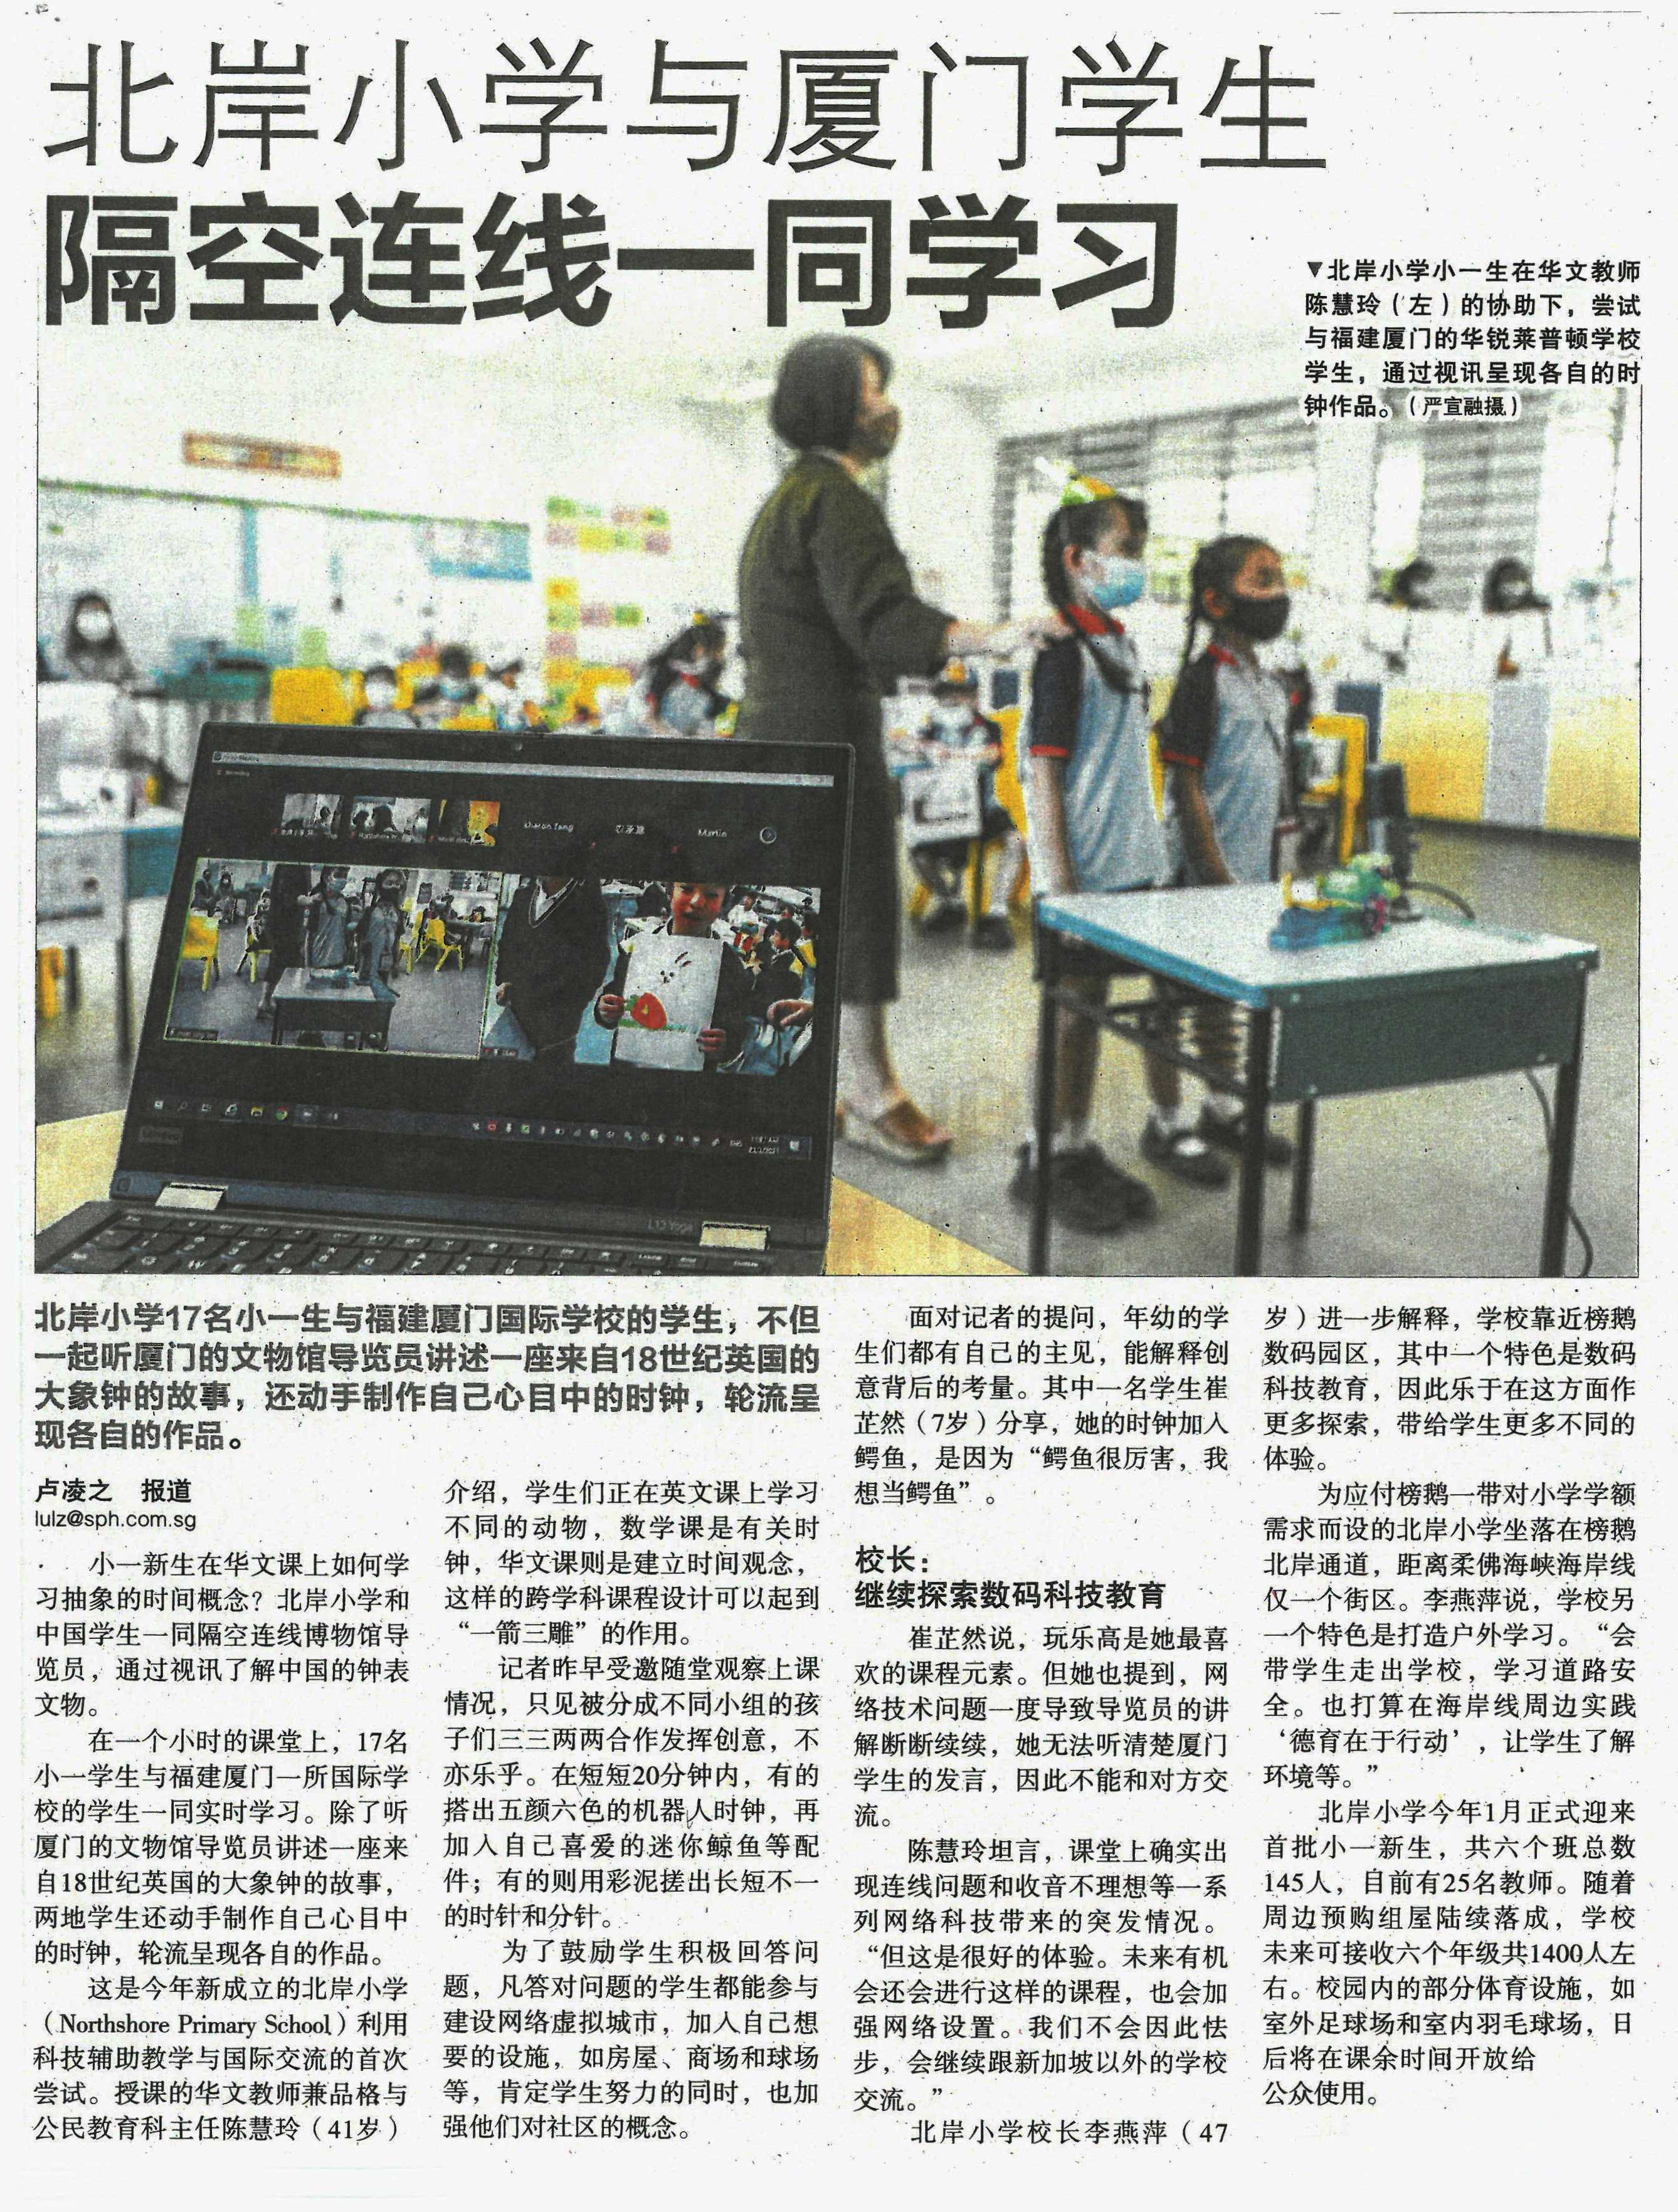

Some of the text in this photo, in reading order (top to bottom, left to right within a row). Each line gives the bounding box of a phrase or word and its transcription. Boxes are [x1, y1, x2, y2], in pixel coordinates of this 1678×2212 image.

[43, 35, 1327, 172] 北岸小学与厦门学生
[45, 190, 1179, 329] 隔空连线一同学习
[1327, 259, 1640, 282] 北岸小学小一生在华文教师
[1305, 292, 1641, 317] 陈慧玲（左）的协助下，尝试
[1305, 326, 1641, 350] 与福建厦门的华锐莱普顿学校
[1305, 361, 1640, 384] 学生，通过视讯呈现各自的时
[34, 1302, 820, 1335] 北岸小学17名小一生与福建厦门国际学校的学生，不但
[909, 1305, 1229, 1330] 面对记者的提问，年幼的学
[34, 1341, 820, 1374] 一起听厦门的文物馆导览员讲述一座来自18世纪英国的
[855, 1339, 1228, 1366] 生们都有自己的主见，能解释创
[1264, 1340, 1636, 1366] 数码园区，其中一个特色是数码
[34, 1380, 820, 1413] 大象钟的故事，还动手制作自己心目中的时钟，轮流呈
[855, 1374, 1228, 1400] 意背后的考量。其中一名学生崔
[1264, 1376, 1636, 1401] 科技教育，因此乐于在这方面作
[34, 1419, 243, 1450] 现各自的作品。
[1264, 1411, 1635, 1436] 更多探索，带给学生更多不同的
[1264, 1446, 1329, 1471] 体验。
[35, 1478, 191, 1502] 卢凌之 报道
[444, 1480, 818, 1505] 介绍，学生们正在英文课上学习
[1318, 1481, 1635, 1507] 为应付榜鹅一带对小学学额
[35, 1510, 196, 1531] lulz@sph.com.sg
[445, 1515, 819, 1540] 不同的动物，数学课是有关时
[1264, 1517, 1636, 1542] 需求而设的北岸小学坐落在榜鹅
[90, 1552, 409, 1577] 小一新生在华文课上如何学
[445, 1550, 808, 1576] 钟，华文课则是建立时间观念，
[855, 1545, 929, 1574] 校长：
[1264, 1552, 1635, 1577] 北岸通道，距离柔佛海峡海岸线
[36, 1586, 409, 1612] 习抽象的时间概念？北岸小学和
[445, 1585, 819, 1611] 这样的跨学科课程设计可以起到
[855, 1579, 1166, 1609] 继续探索数码科技教育
[1264, 1587, 1634, 1613] 仅一个街区。李燕萍说，学校另
[36, 1621, 409, 1647] 中国学生一同隔空连线博物馆导
[909, 1626, 1228, 1651] 崔芷然说，玩乐高是她最喜
[34, 1657, 409, 1683] 览员，通过视讯了解中国的钟表
[499, 1656, 820, 1681] 记者昨早受邀随堂观察上课
[854, 1661, 1227, 1687] 欢的课程元素。但她也提到，网
[1264, 1657, 1636, 1683] 带学生走出学校，学习道路安
[34, 1692, 99, 1717] 文物。
[445, 1691, 819, 1717] 情况，只见被分成不同小组的孩
[854, 1696, 1229, 1722] 络技术问题一度导致导览员的讲
[1263, 1693, 1636, 1718] 全。也打算在海岸线周边实践
[88, 1728, 407, 1754] 在一个小时的课堂上，17名
[444, 1726, 819, 1752] 子们三三两两合作发挥创意，不
[853, 1732, 1227, 1757] 解断断续续，她无法听清楚厦门
[34, 1763, 408, 1789] 小一学生与福建厦门一所国际学
[443, 1762, 819, 1788] 亦乐乎。在短短20分钟内，有的
[853, 1767, 1228, 1793] 学生的发言，因此不能和对方交
[34, 1799, 408, 1824] 校的学生一同实时学习。除了听
[443, 1798, 819, 1823] 搭出五颜六色的机器人时钟，再
[855, 1803, 892, 1828] 流。
[1318, 1799, 1635, 1824] 北岸小学今年1月正式迎来
[34, 1835, 408, 1860] 厦门的文物馆导览员讲述一座来
[444, 1833, 819, 1858] 加入自己喜爱的迷你鲸鱼等配
[909, 1838, 1227, 1863] 陈慧玲坦言，课堂上确实出
[1264, 1835, 1635, 1860] 首批小一新生，共六个班总数
[36, 1870, 396, 1896] 自18世纪英国的大象钟的故事，
[443, 1868, 819, 1893] 件；有的则用彩泥搓出长短不一
[854, 1873, 1227, 1899] 现连线问题和收音不理想等一系
[1264, 1870, 1635, 1895] 145人，目前有25名教师。随着
[34, 1905, 407, 1930] 两地学生还动手制作自己心目中
[444, 1904, 615, 1929] 的时针和分针。
[853, 1909, 1216, 1934] 列网络科技带来的突发情况。
[1263, 1905, 1635, 1930] 周边预购组屋陆续落成，学校
[35, 1940, 382, 1966] 的时钟，轮流呈现各自的作品。
[503, 1939, 818, 1964] 为了鼓励学生积极回答问
[1263, 1941, 1635, 1966] 未来可接收六个年级共1400人左
[88, 1976, 408, 2001] 这是今年新成立的北岸小学
[443, 1974, 818, 1999] 题，凡答对问题的学生都能参与
[853, 1979, 1227, 2005] 会还会进行这样的课程，也会加
[1263, 1976, 1635, 2001] 右。校园内的部分体育设施，如
[178, 2014, 257, 2039] Primary
[443, 2009, 818, 2035] 建设网络虚拟城市，加入自己想
[853, 2014, 1228, 2040] 强网络设置。我们不会因此怯
[1263, 2011, 1632, 2036] 室外足球场和室内羽毛球场，日
[33, 2046, 408, 2072] 科技辅助教学与国际交流的首次
[443, 2045, 818, 2070] 要的设施，如房屋、商场和球场
[853, 2050, 1227, 2075] 步，会继续跟新加坡以外的学校
[1263, 2045, 1536, 2071] 后将在课余时间开放给
[33, 2081, 407, 2106] 尝试。授课的华文教师兼品格与
[443, 2079, 818, 2105] 等，肯定学生努力的同时，也加
[1263, 2081, 1380, 2106] 公众使用。
[443, 2114, 693, 2140] 强他们对社区的概念。
